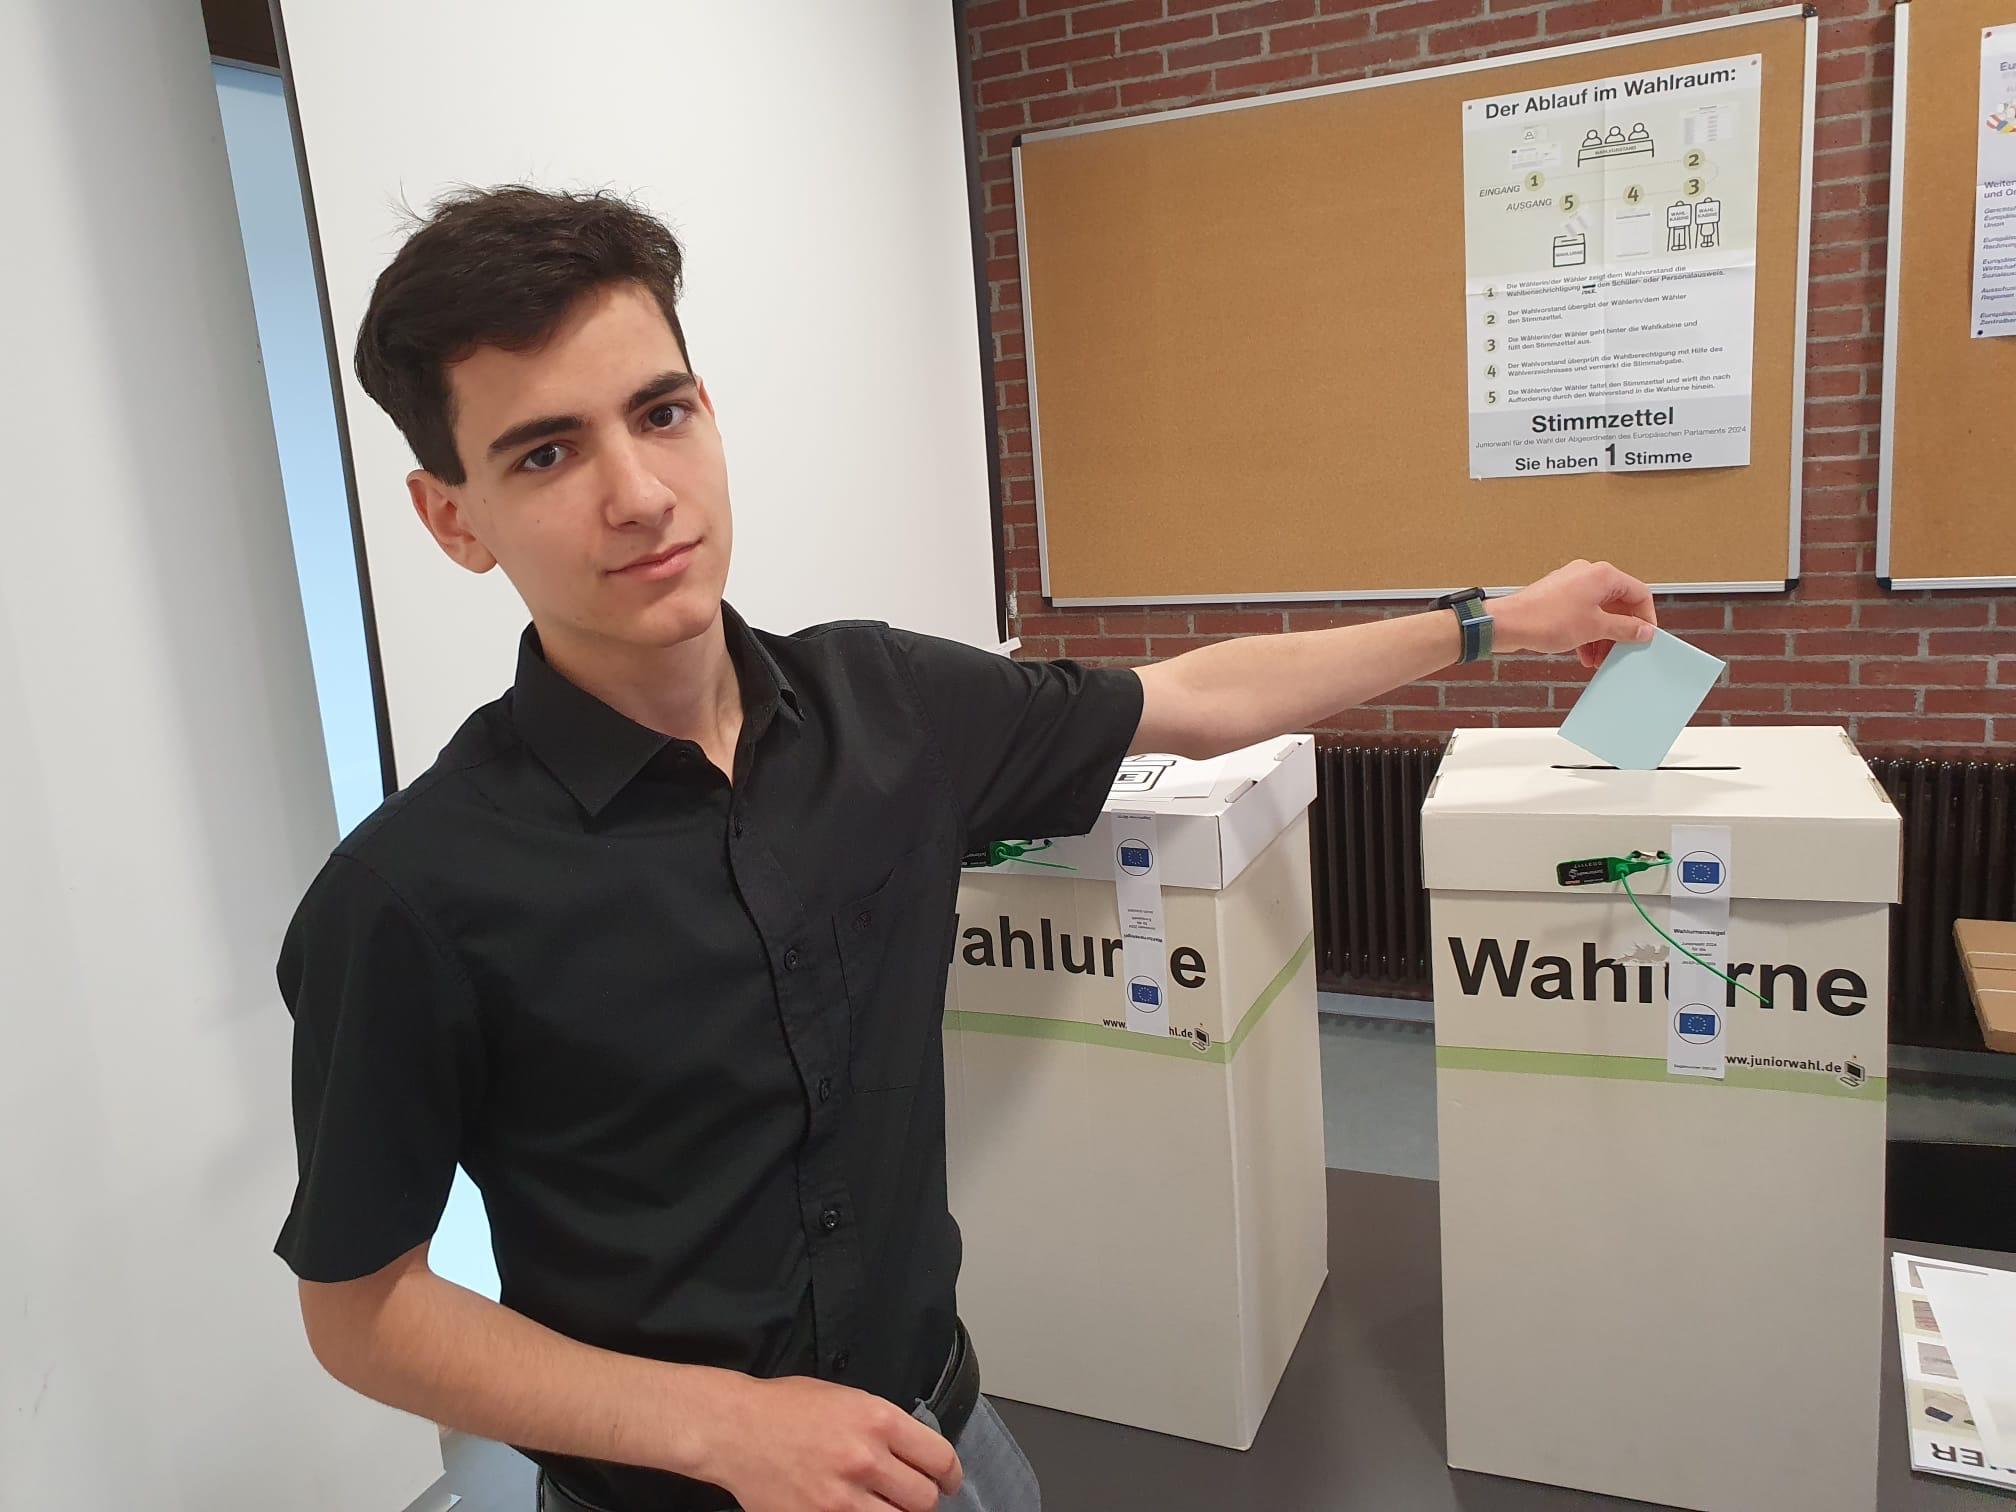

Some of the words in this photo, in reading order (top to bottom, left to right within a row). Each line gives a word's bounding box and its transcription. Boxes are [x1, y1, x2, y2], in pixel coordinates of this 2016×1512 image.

[2000, 61, 2016, 71] Eu
[1485, 101, 1519, 119] Der
[1525, 90, 1587, 113] Ablauf
[1594, 86, 1617, 101] im
[1624, 68, 1736, 97] Wahlraum:
[1688, 154, 1699, 166] 2
[1530, 175, 1538, 187] 1
[1688, 178, 1700, 195] 3
[1480, 185, 1520, 197] EINGANG
[1628, 186, 1639, 202] 4
[1984, 190, 2003, 199] und
[1506, 198, 1552, 211] AUSGANG
[1564, 195, 1574, 210] 5
[1625, 267, 1674, 276] Wahlvorstand
[1487, 288, 1494, 297] 1
[1506, 285, 1581, 297] Wahlbenachrichtigung
[1521, 306, 1567, 315] Wahlvorstand
[1568, 303, 1596, 311] übergibt
[1611, 297, 1660, 306] Wählerin/dem
[1661, 293, 1687, 301] Wähler
[1487, 315, 1495, 324] 2
[1641, 322, 1682, 331] Wahlkabine
[1487, 339, 1496, 351] 3
[1536, 339, 1576, 349] Stimmzettel
[1521, 359, 1567, 368] Wahlvorstand
[1613, 350, 1676, 360] Wahlberechtigung
[1589, 360, 1619, 370] vermerkt
[1487, 365, 1496, 378] 4
[1623, 378, 1664, 387] Stimmzettel
[1488, 392, 1496, 403] 5
[1508, 395, 1551, 403] Aufforderung
[1589, 389, 1634, 398] Wahlvorstand
[1656, 385, 1690, 393] Wahlurne
[1532, 406, 1673, 433] Stimmzettel
[1476, 440, 1511, 449] Juniorwahl
[1568, 434, 1616, 443] Abgeordneten
[1633, 430, 1682, 440] Europäischen
[1684, 428, 1726, 436] Parlaments
[1515, 457, 1540, 471] Sie
[1546, 456, 1598, 469] haben
[1605, 443, 1615, 466] 1
[1625, 451, 1693, 465] Stimme
[949, 913, 1207, 988] ahlure
[1447, 936, 1868, 1016] Wahlrne
[1725, 1055, 1842, 1072] ww.juniorwahl.de
[1930, 1442, 1999, 1470] ER
